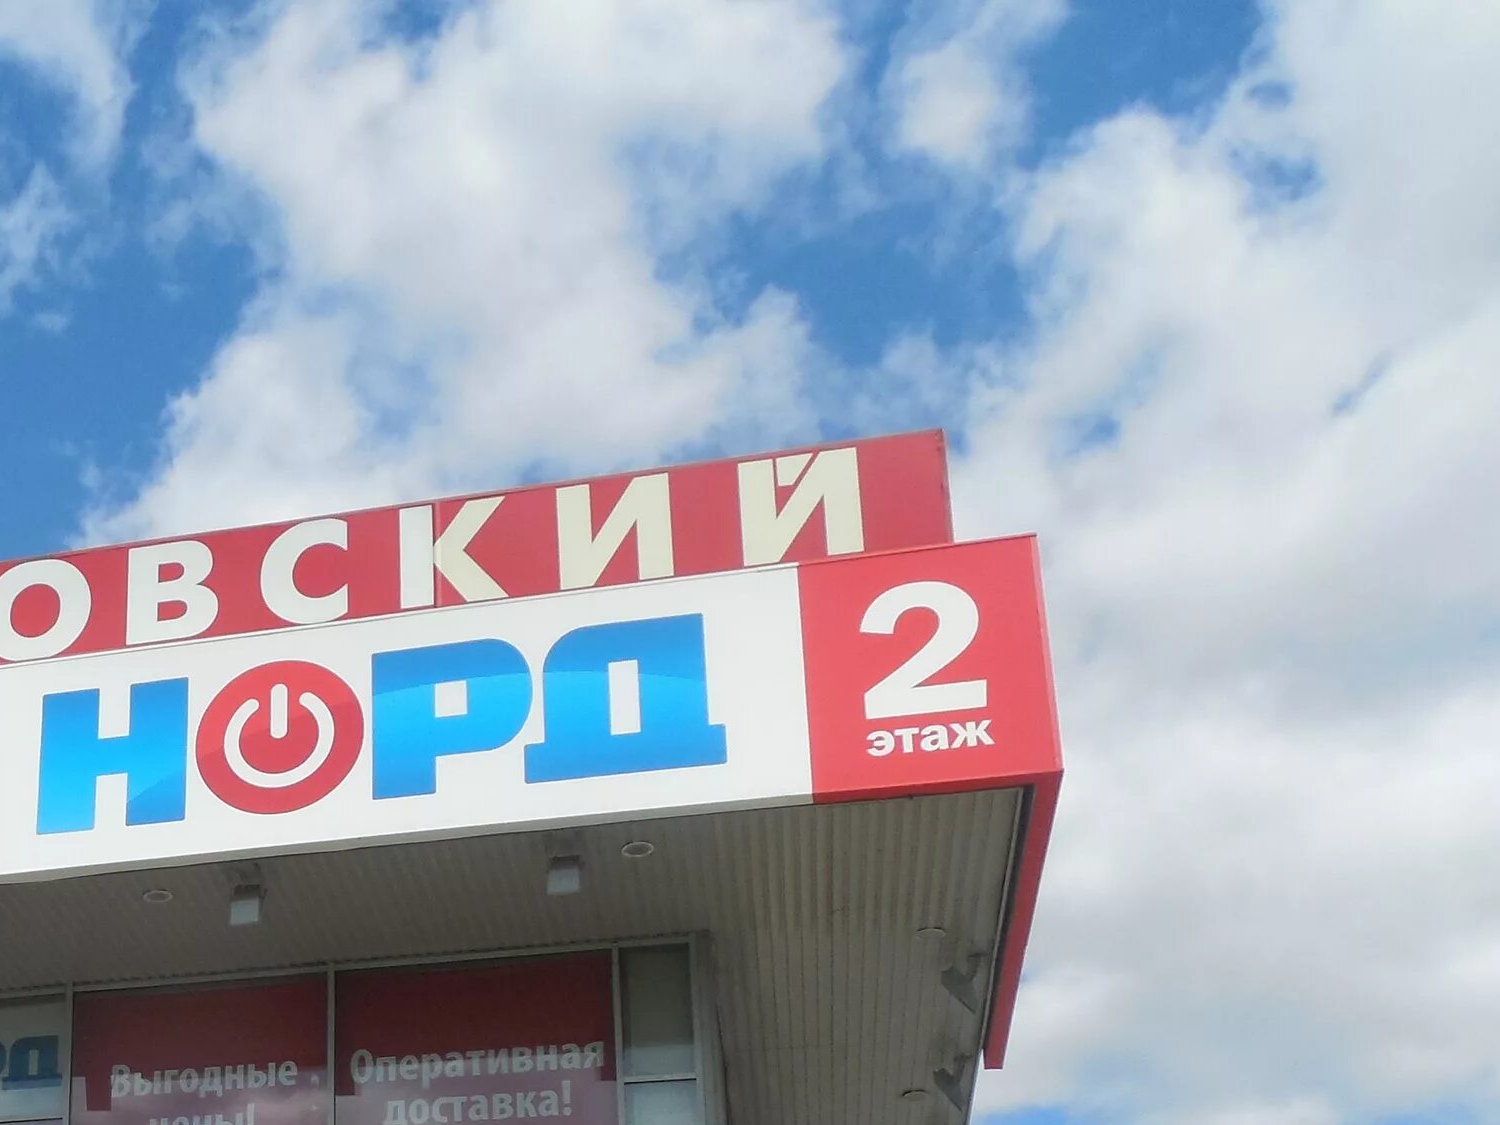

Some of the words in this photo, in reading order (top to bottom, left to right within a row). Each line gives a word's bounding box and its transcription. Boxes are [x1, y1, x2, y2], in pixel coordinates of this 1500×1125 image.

[858, 580, 988, 719] 2
[36, 613, 729, 835] НОРД
[865, 718, 995, 756] этаж
[110, 1056, 298, 1099] Выгодные
[350, 1041, 605, 1086] Оперативная
